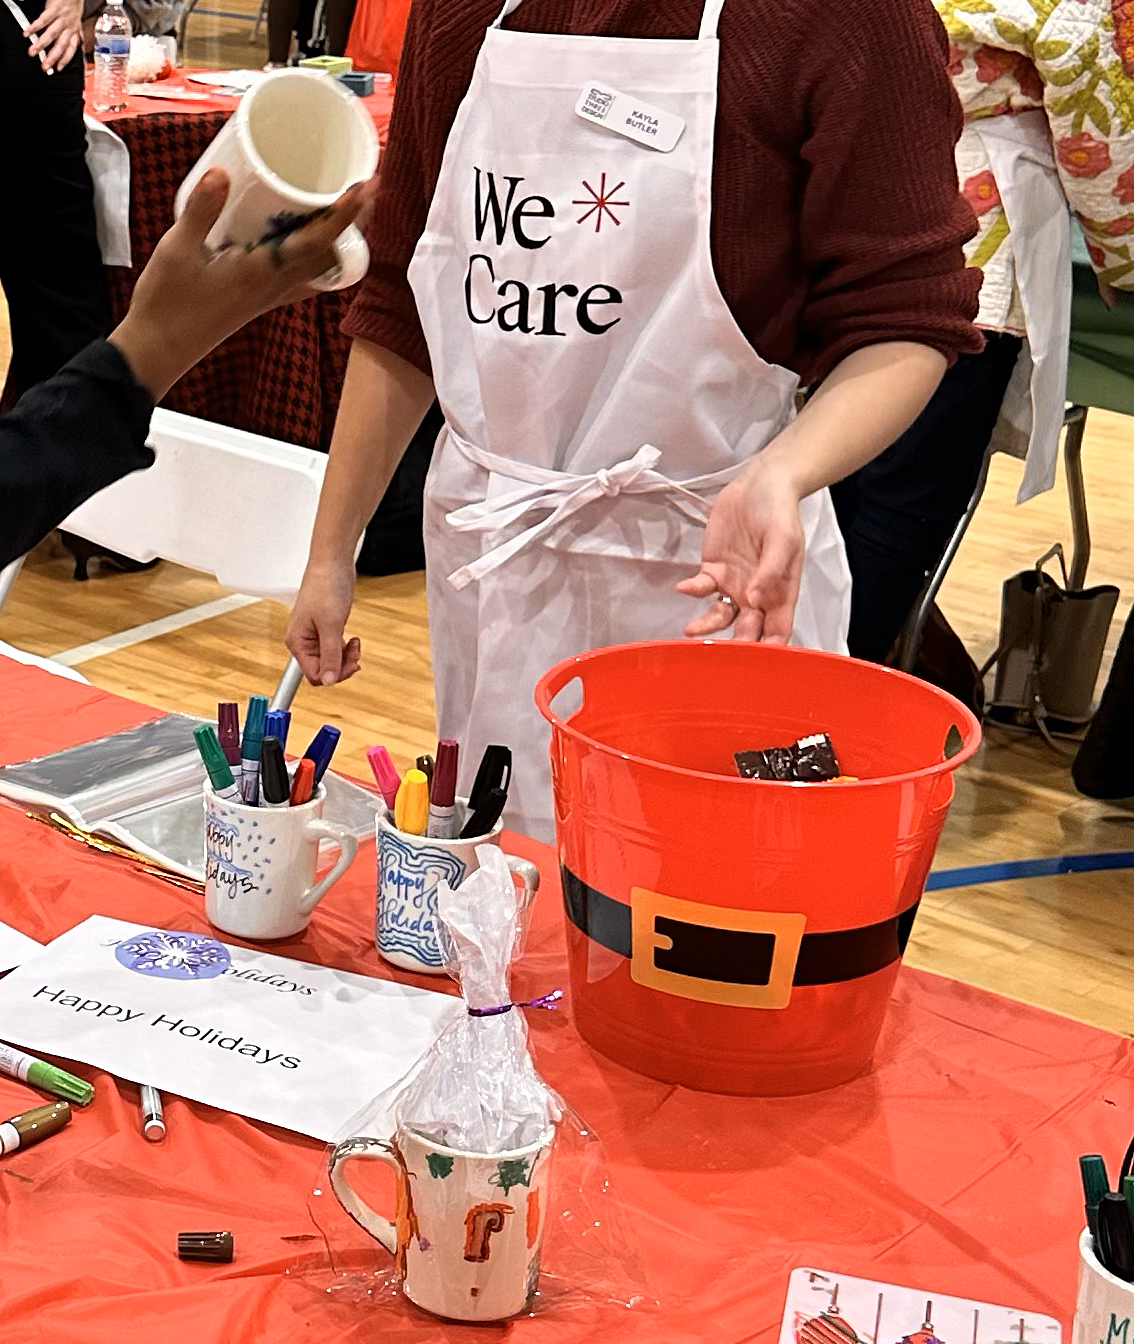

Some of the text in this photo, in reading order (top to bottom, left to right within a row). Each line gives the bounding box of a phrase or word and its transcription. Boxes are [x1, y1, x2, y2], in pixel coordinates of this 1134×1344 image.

[625, 117, 658, 136] BUTLER
[631, 110, 659, 126] KAYLA
[473, 166, 555, 250] We
[464, 253, 623, 337] Care
[377, 853, 440, 908] Happy
[377, 895, 435, 933] Holida
[219, 964, 317, 996] olidays
[32, 985, 302, 1069] Happy Holidays
